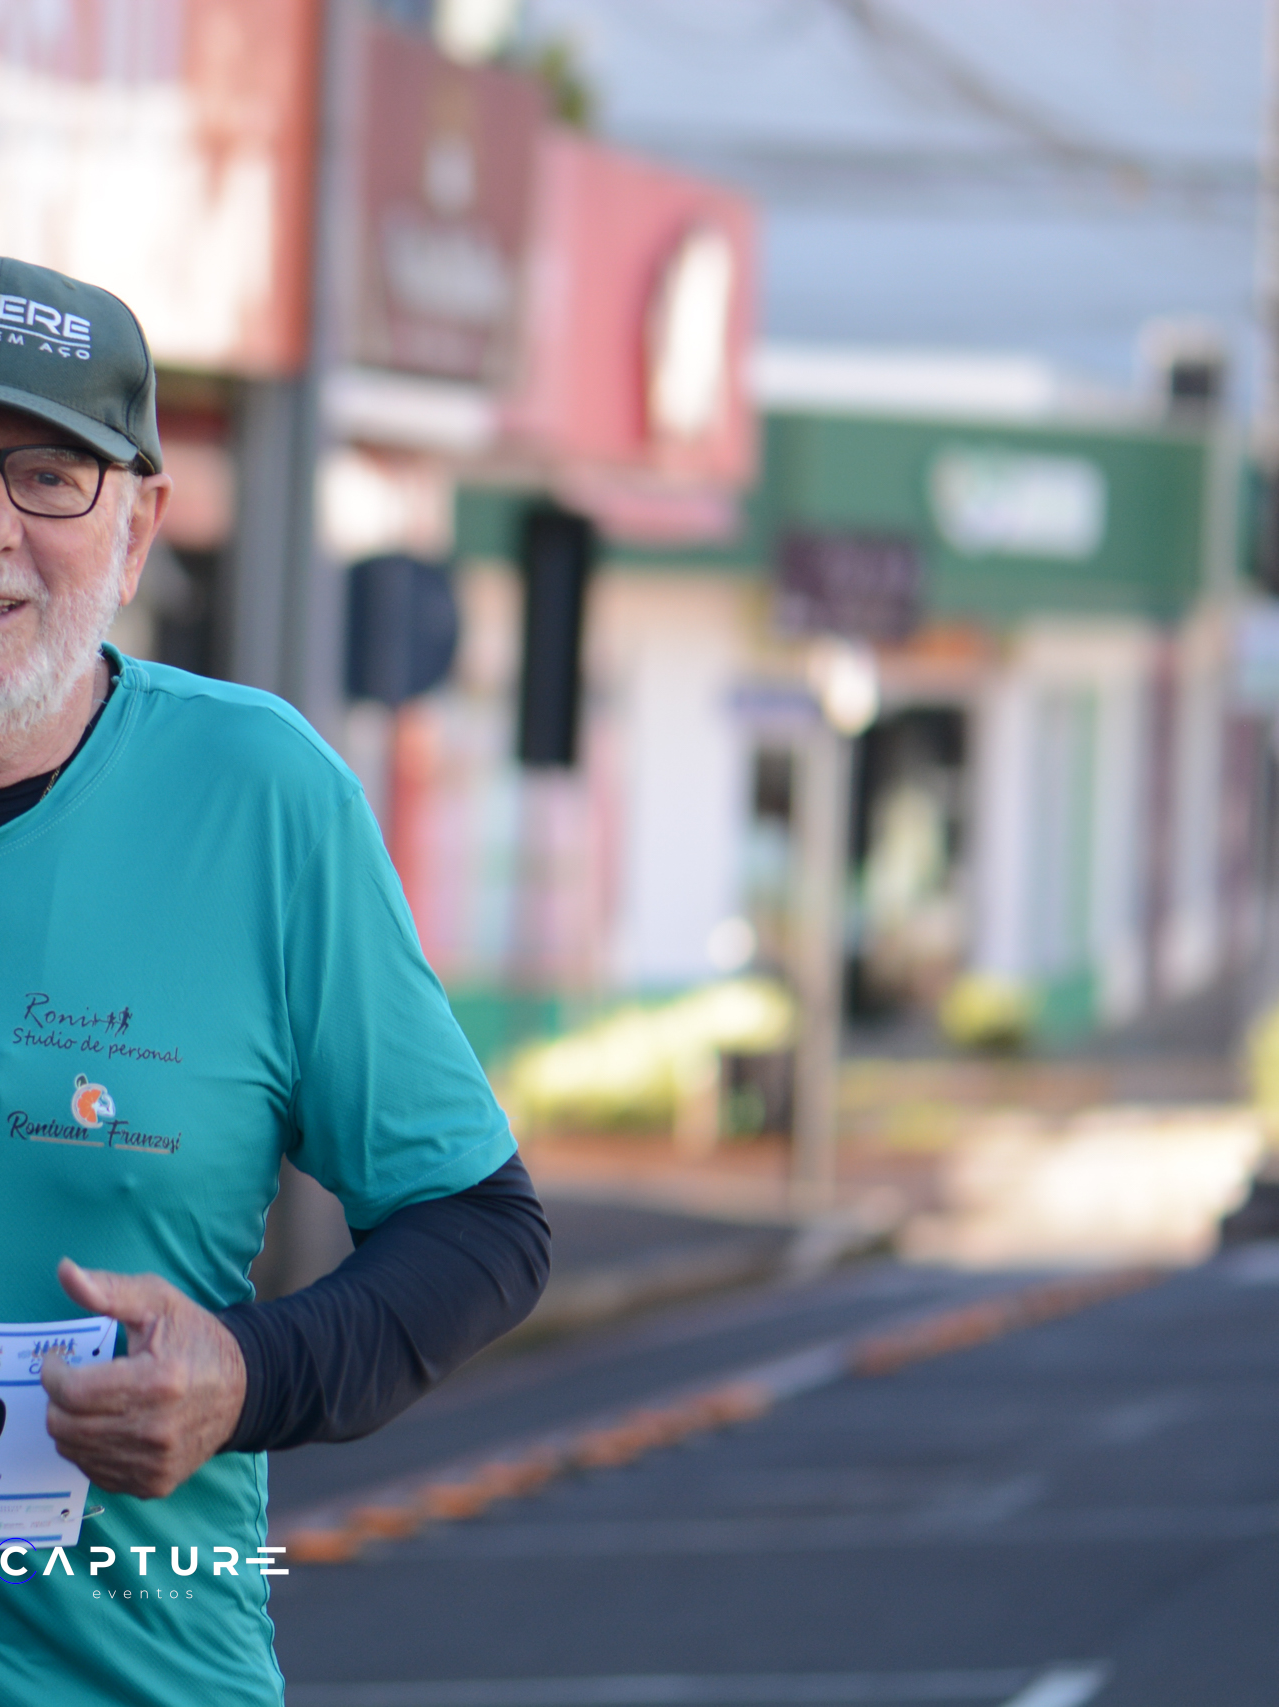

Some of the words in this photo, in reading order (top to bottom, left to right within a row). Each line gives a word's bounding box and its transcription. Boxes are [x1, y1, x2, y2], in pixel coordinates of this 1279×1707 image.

[39, 342, 91, 361] AÇO
[12, 1027, 77, 1051] Studio
[80, 1035, 105, 1053] de
[107, 1042, 183, 1064] personal
[7, 1110, 90, 1141] Ronivan
